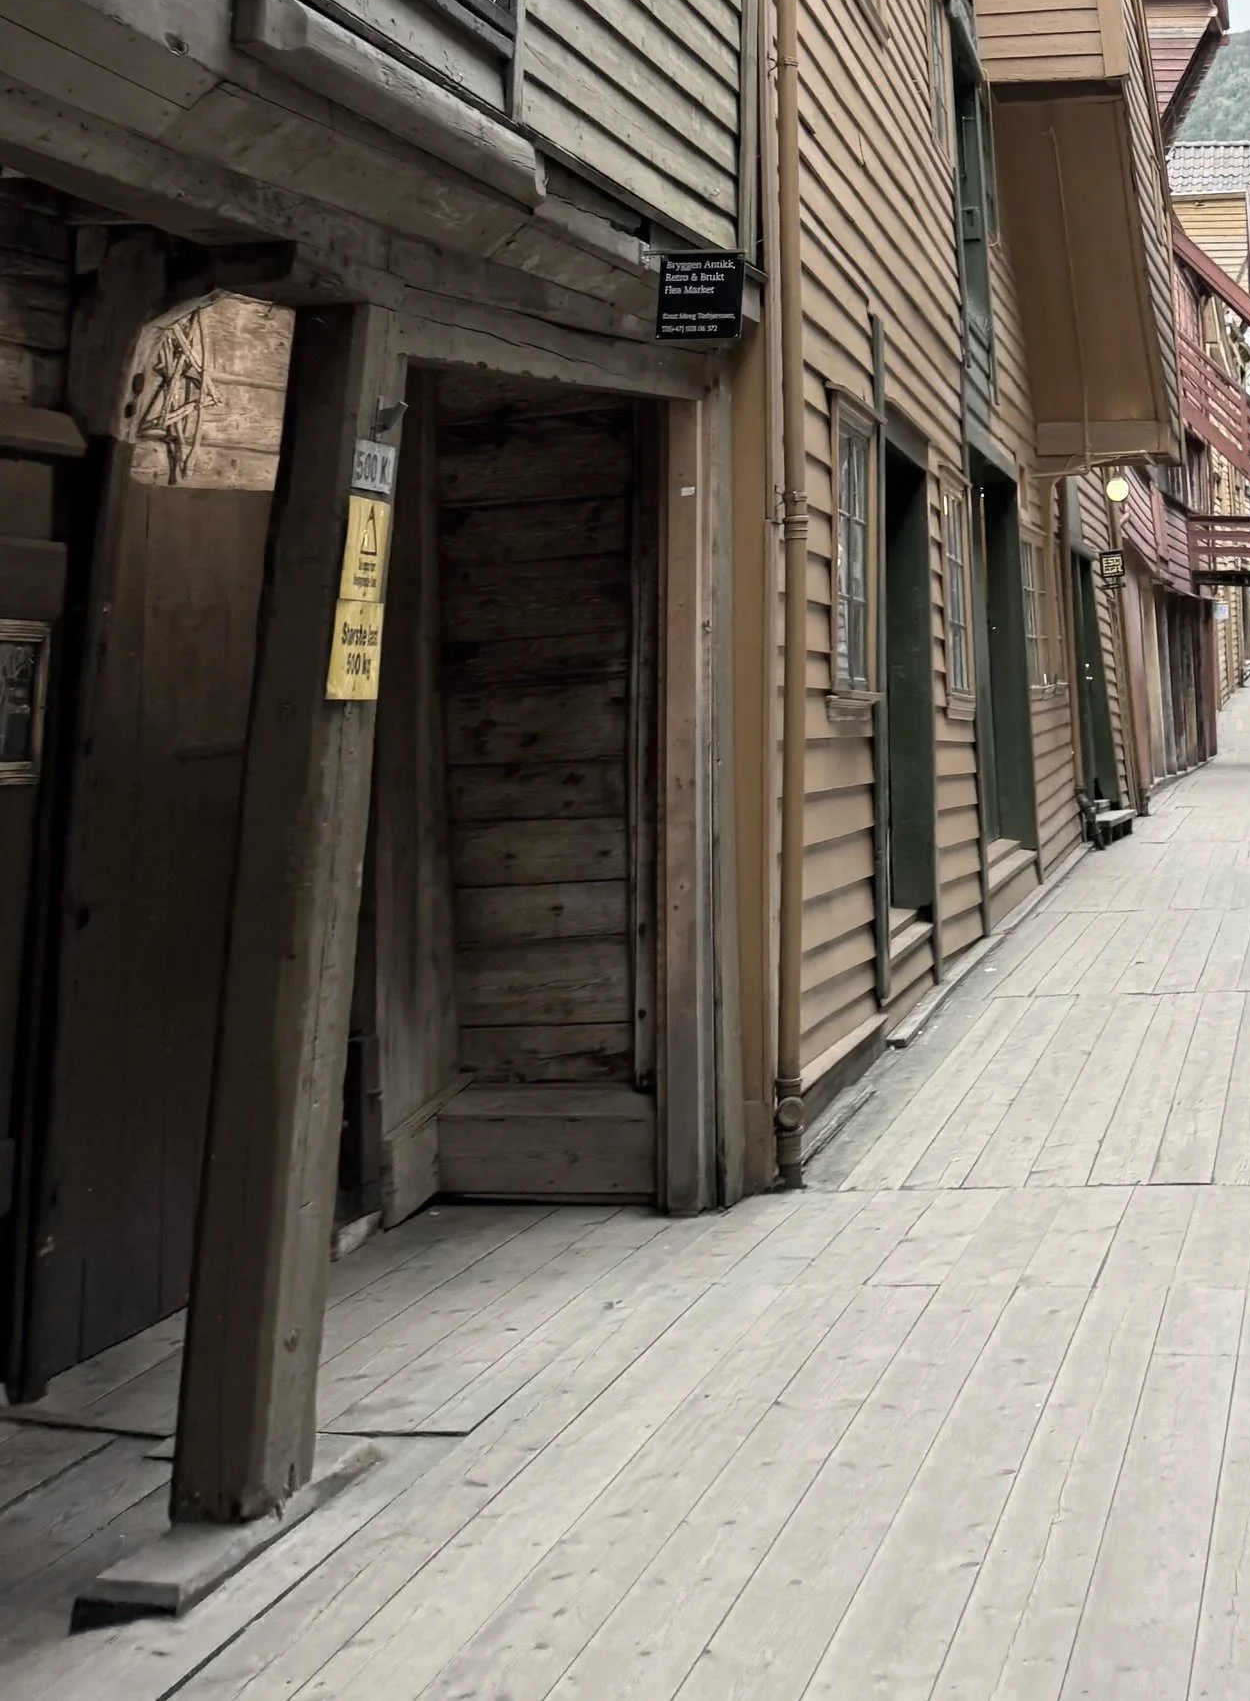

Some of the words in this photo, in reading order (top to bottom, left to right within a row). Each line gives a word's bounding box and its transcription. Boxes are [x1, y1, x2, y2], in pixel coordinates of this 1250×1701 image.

[666, 261, 702, 271] Bryggen
[665, 273, 689, 282] Retro
[691, 273, 698, 282] &
[700, 272, 725, 281] Brukt
[664, 285, 682, 294] Flea
[683, 285, 715, 294] Market
[355, 451, 378, 484] 500
[341, 621, 367, 646] Største
[346, 652, 361, 676] 500
[361, 652, 371, 680] kg
